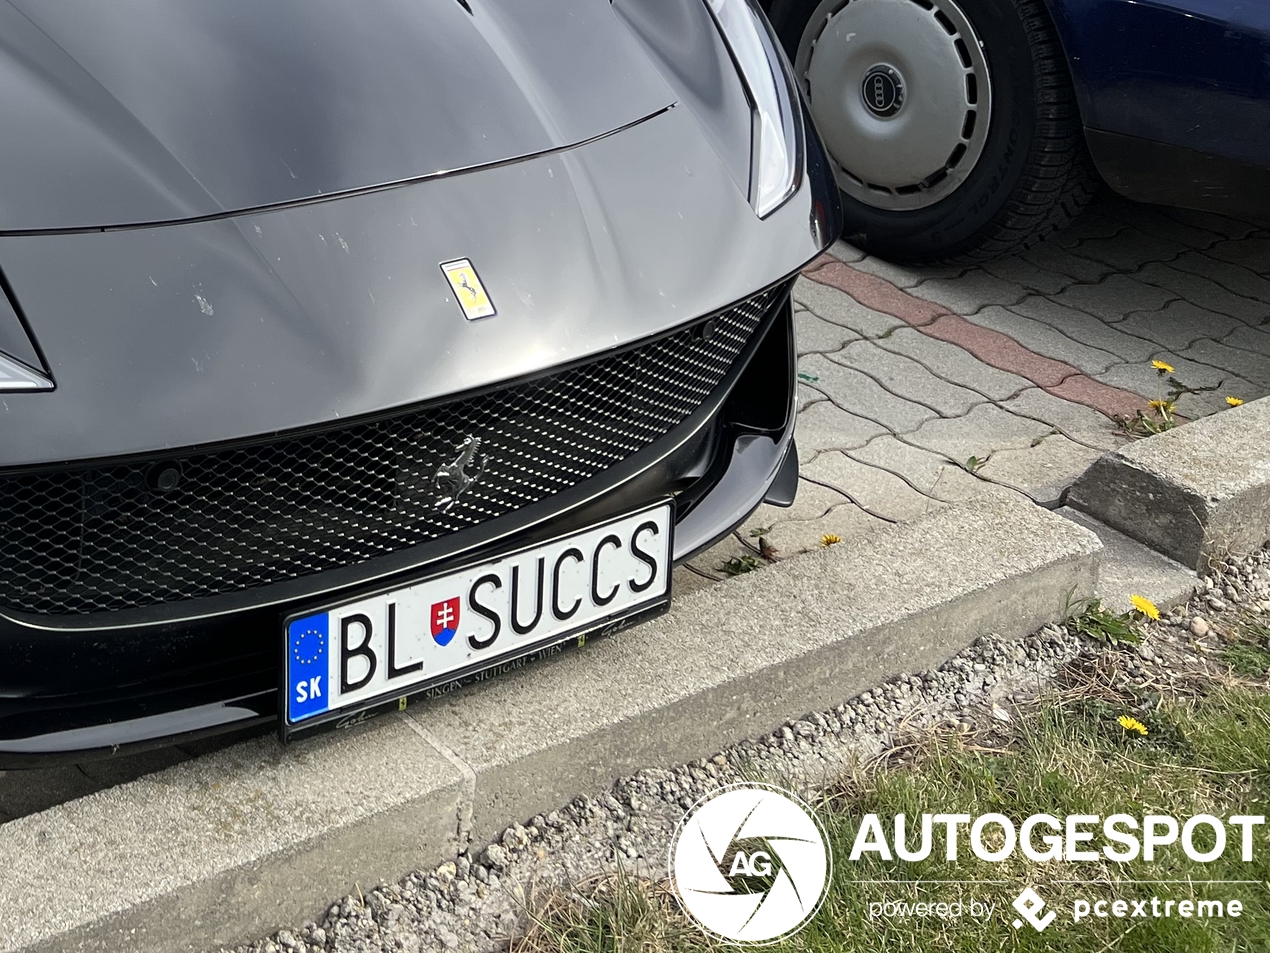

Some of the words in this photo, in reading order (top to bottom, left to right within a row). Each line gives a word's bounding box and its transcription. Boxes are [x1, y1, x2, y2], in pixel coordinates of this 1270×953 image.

[340, 600, 424, 695] BL
[466, 521, 660, 650] SUCCS
[296, 675, 322, 703] SK
